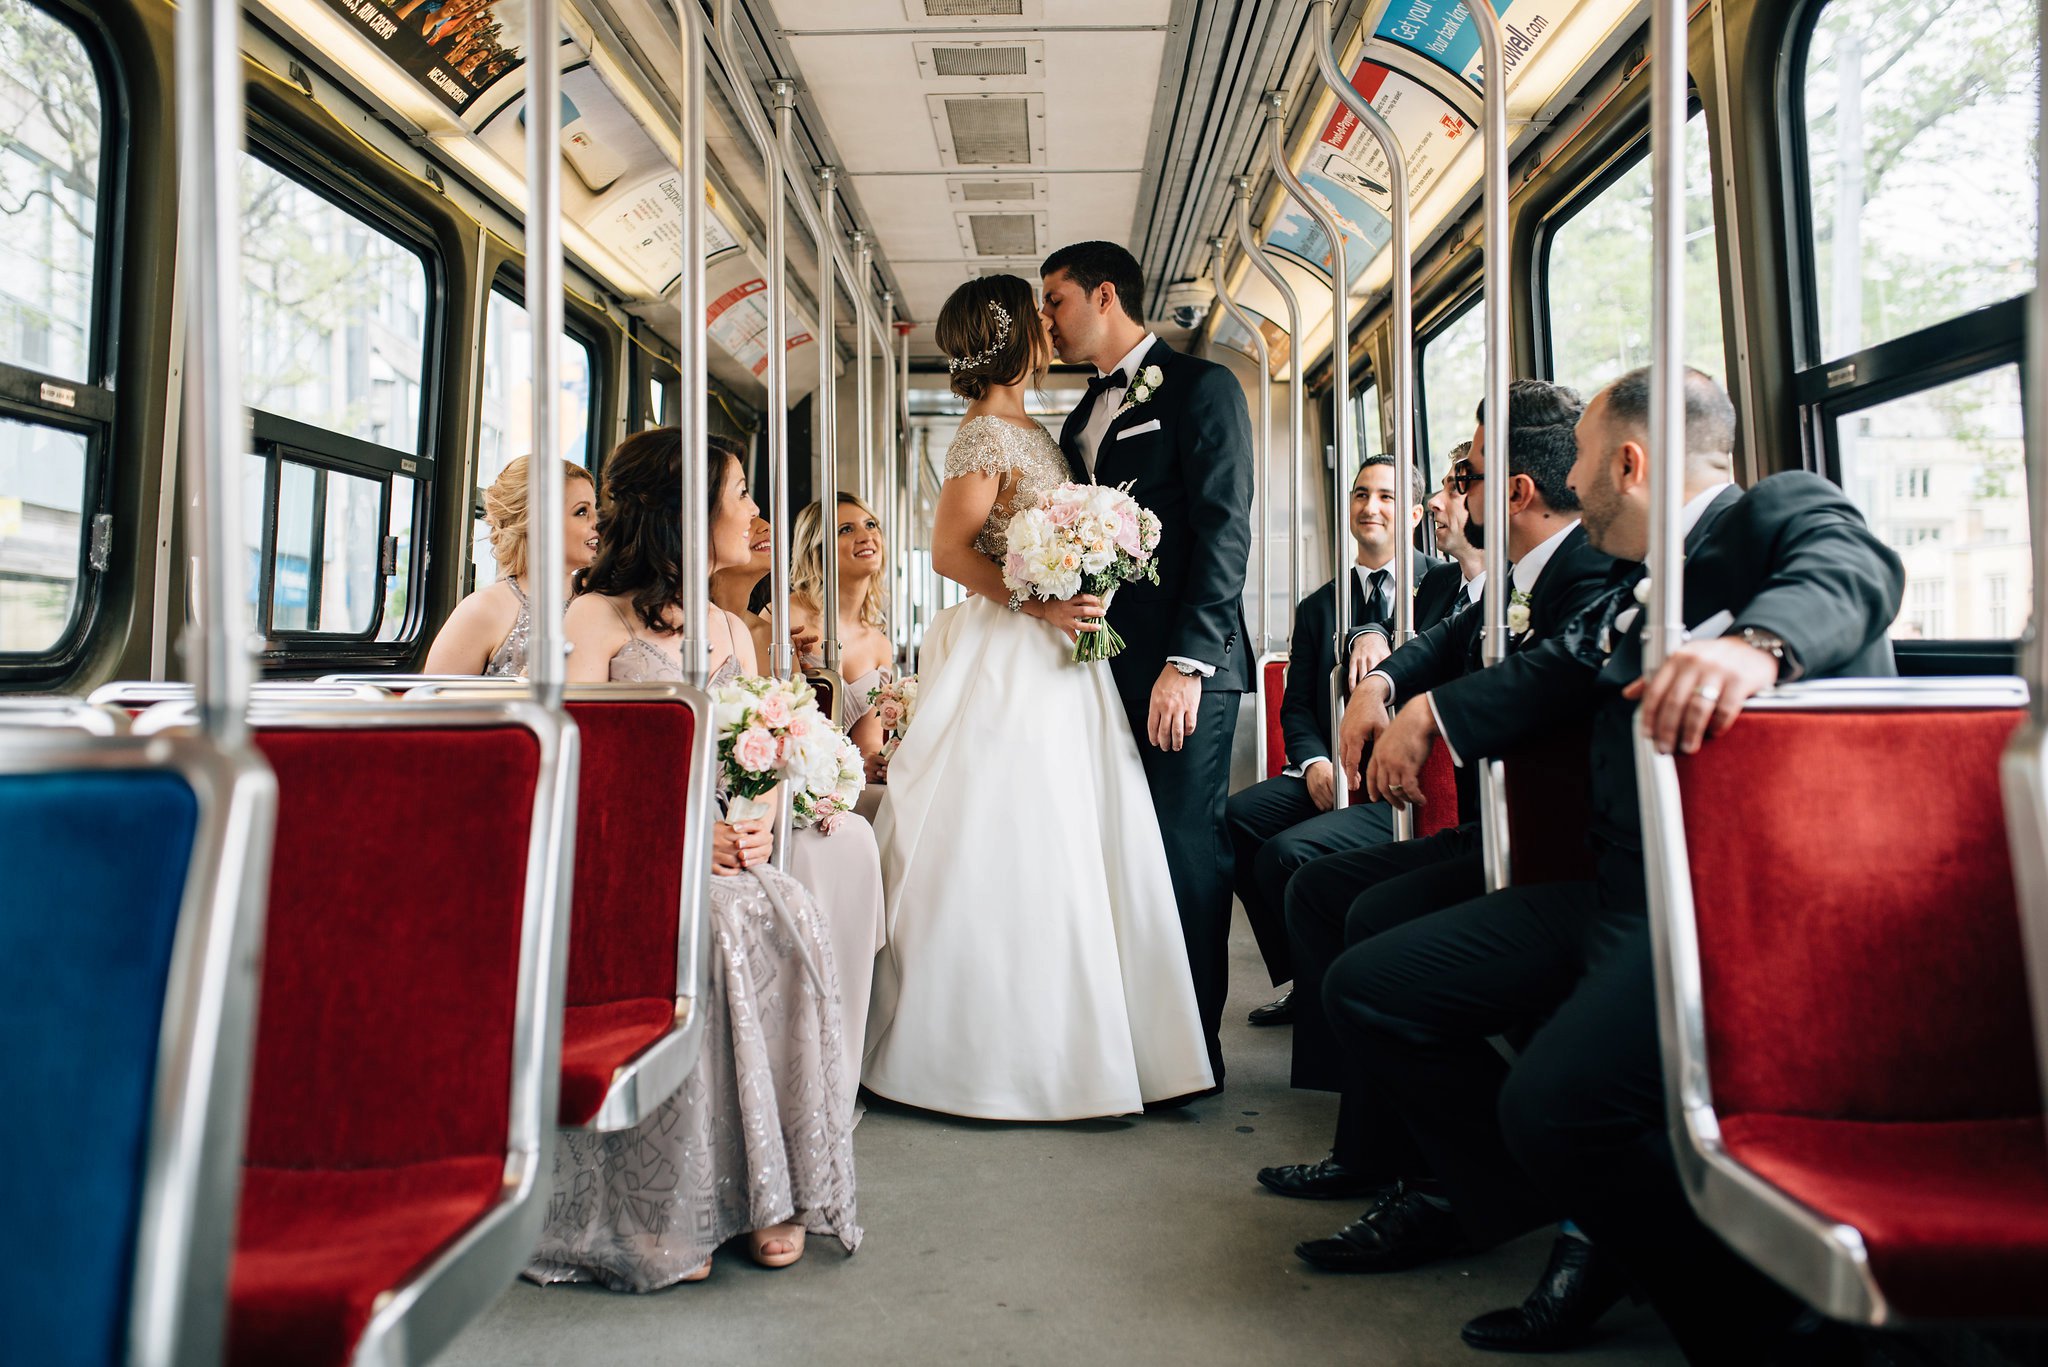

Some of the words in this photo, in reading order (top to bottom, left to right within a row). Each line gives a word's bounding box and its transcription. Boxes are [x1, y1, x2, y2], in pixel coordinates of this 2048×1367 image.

[356, 2, 379, 23] RUN
[369, 13, 398, 40] CREWS
[1391, 19, 1421, 41] Get
[1434, 17, 1461, 40] bank
[1425, 35, 1449, 55] Your
